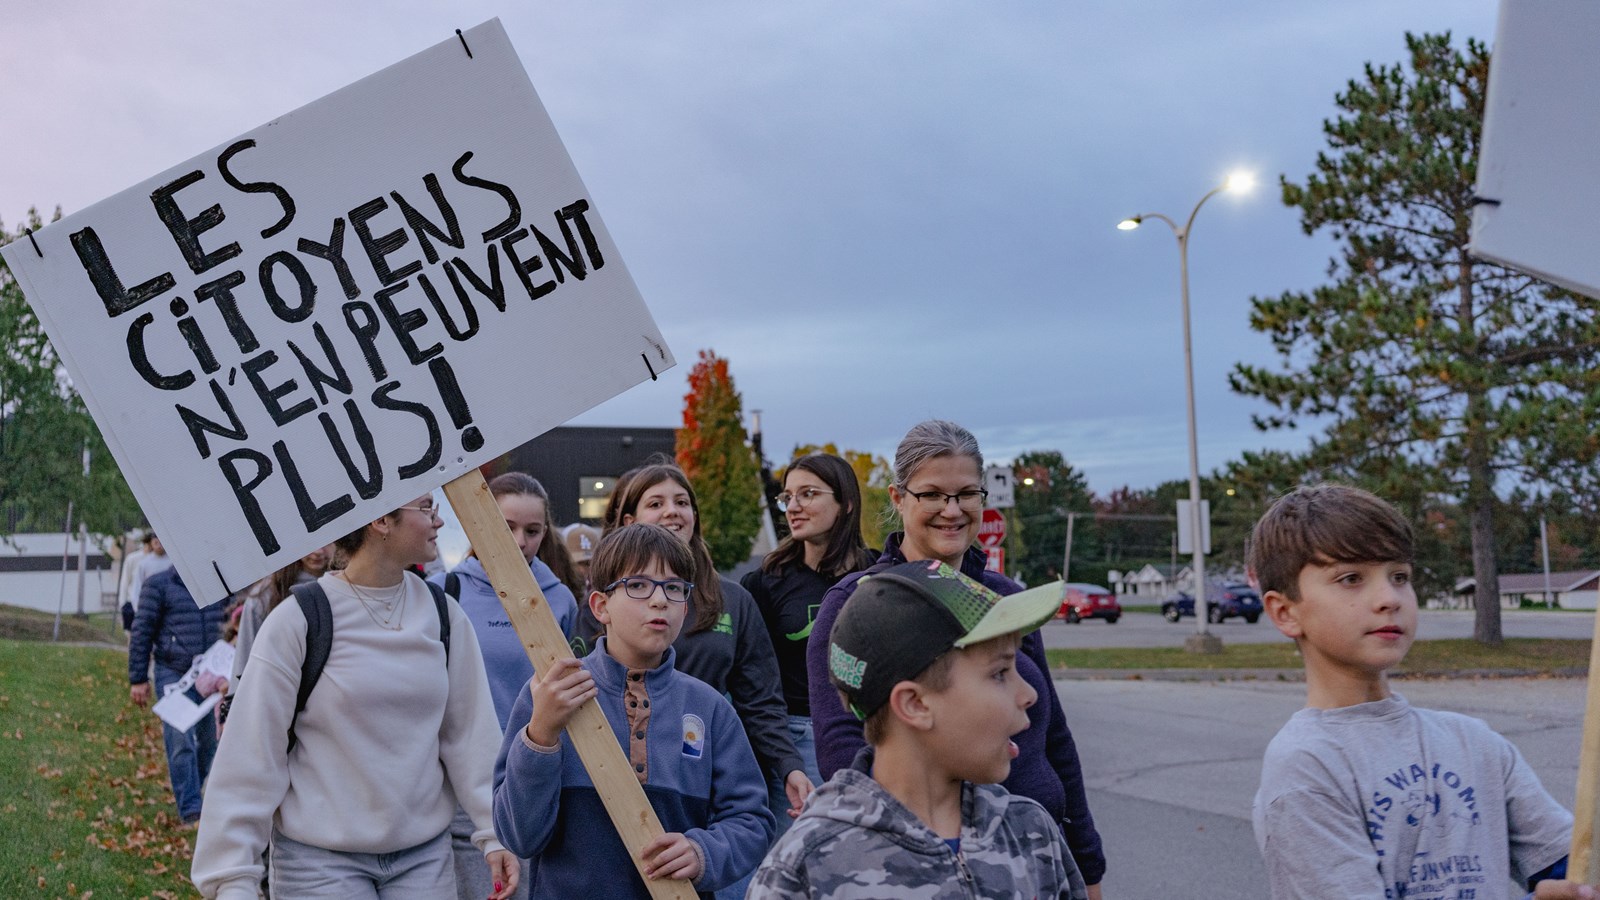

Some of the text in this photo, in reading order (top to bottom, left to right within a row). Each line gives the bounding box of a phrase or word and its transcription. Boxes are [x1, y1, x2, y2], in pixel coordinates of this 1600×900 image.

[68, 138, 296, 319] LES
[174, 198, 605, 460] N'EN PEUVENT
[217, 355, 485, 557] PLUS!
[1366, 791, 1395, 857] HIS
[1384, 763, 1427, 791] WA
